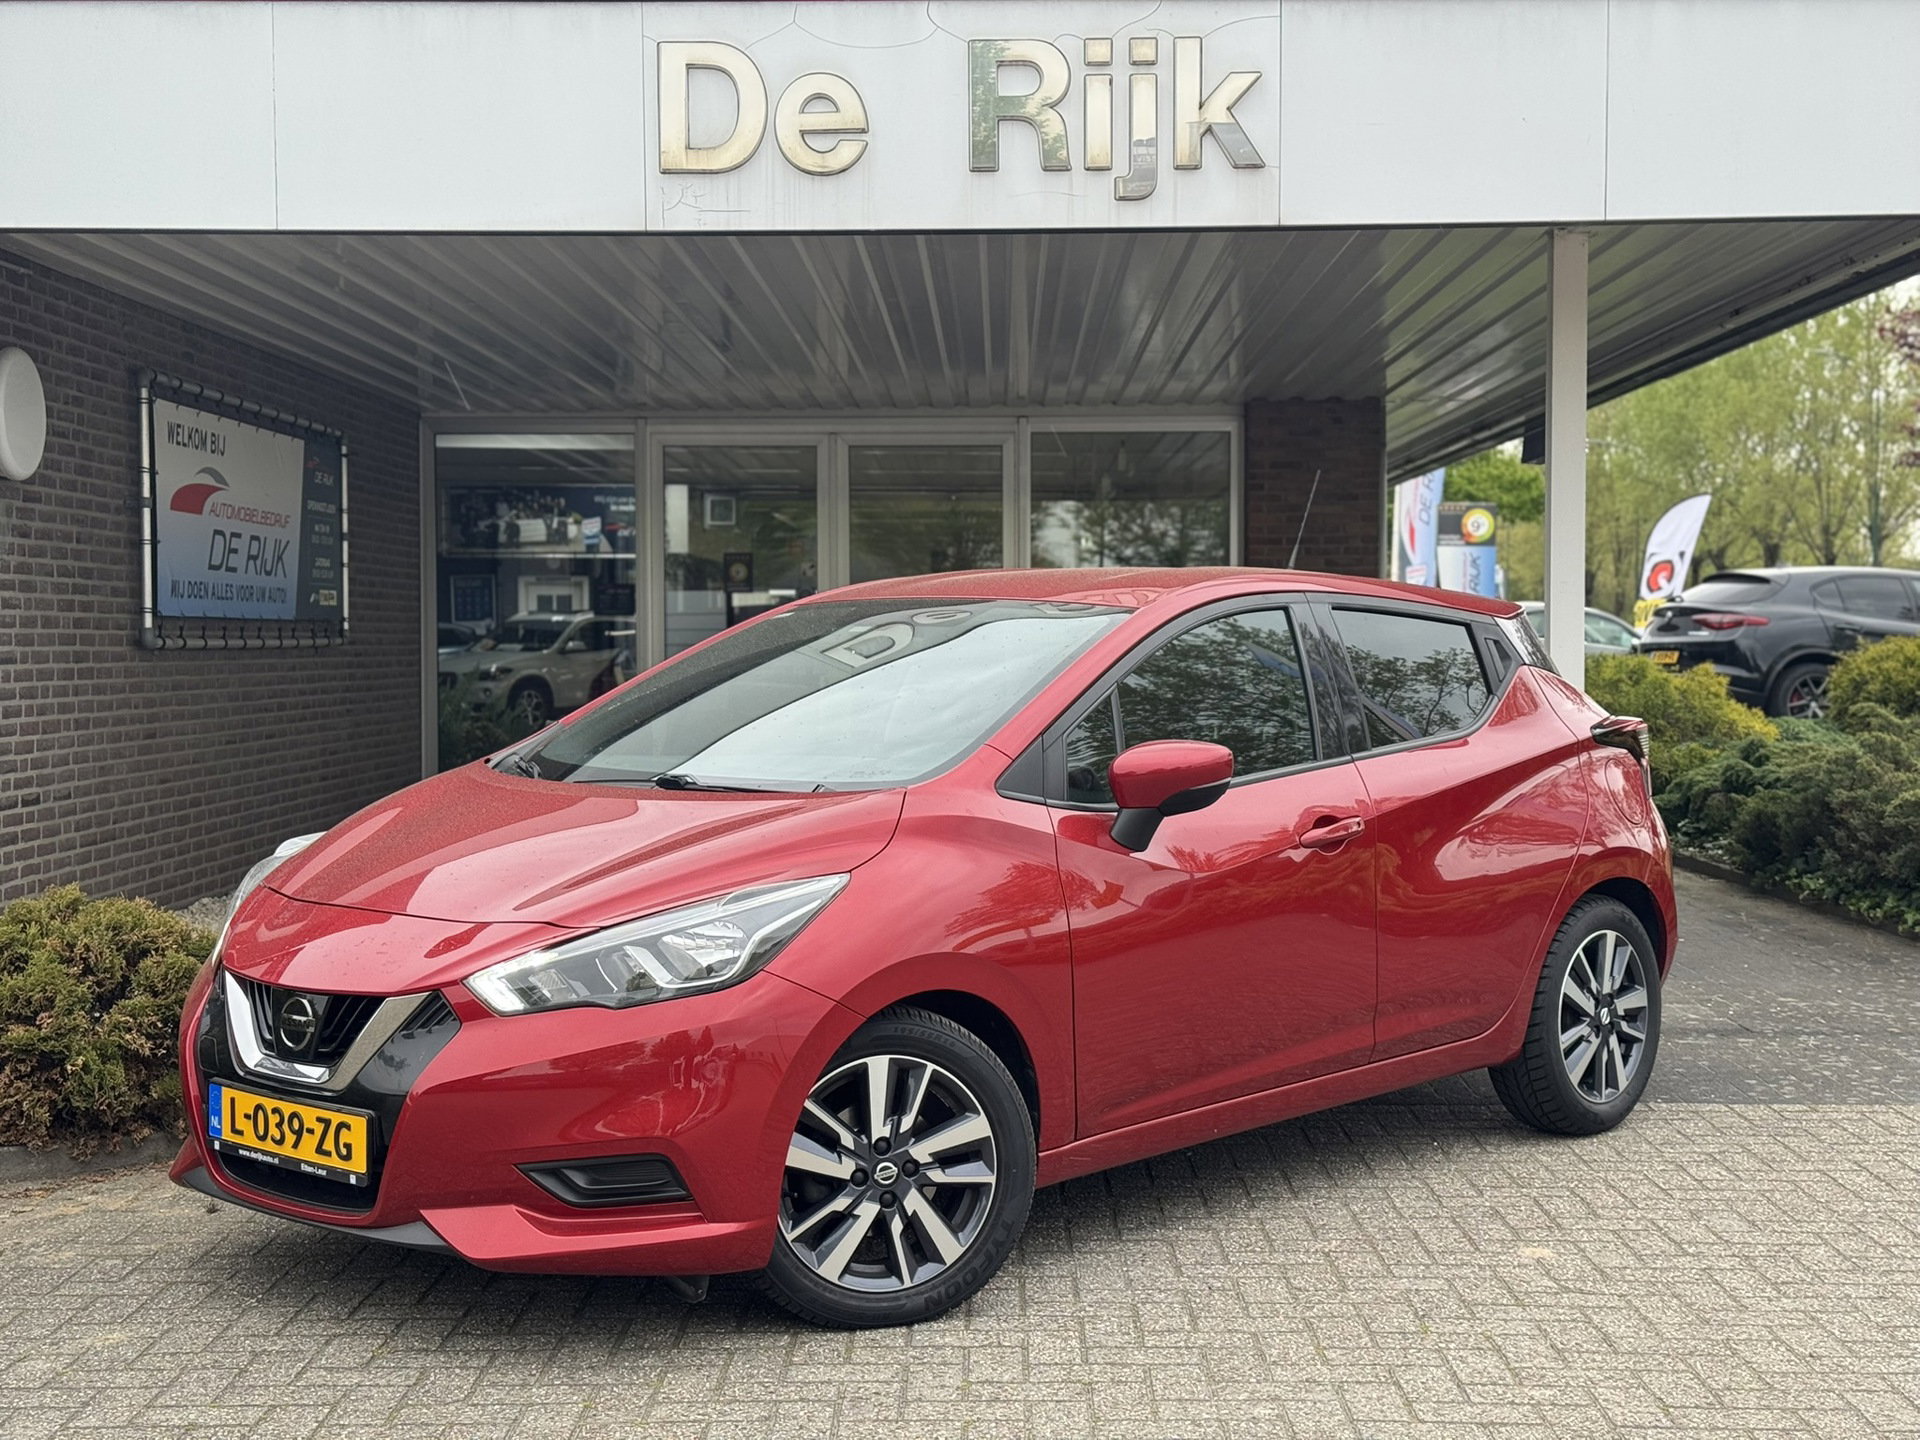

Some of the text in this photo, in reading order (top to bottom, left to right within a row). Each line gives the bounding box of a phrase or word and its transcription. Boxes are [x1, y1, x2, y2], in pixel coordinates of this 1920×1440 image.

[657, 36, 1266, 201] De Rijk
[167, 421, 226, 456] WELKOM BIJ
[209, 501, 291, 529] AUTOMOBIELBEDRIJF
[208, 529, 291, 579] DE RIJK
[170, 579, 185, 599] WIJ
[187, 580, 209, 600] DOEN
[211, 582, 235, 601] ALLES
[236, 583, 255, 603] VOOR
[256, 585, 267, 604] UW
[211, 1114, 221, 1129] NL
[229, 1096, 353, 1162] L-039-ZG
